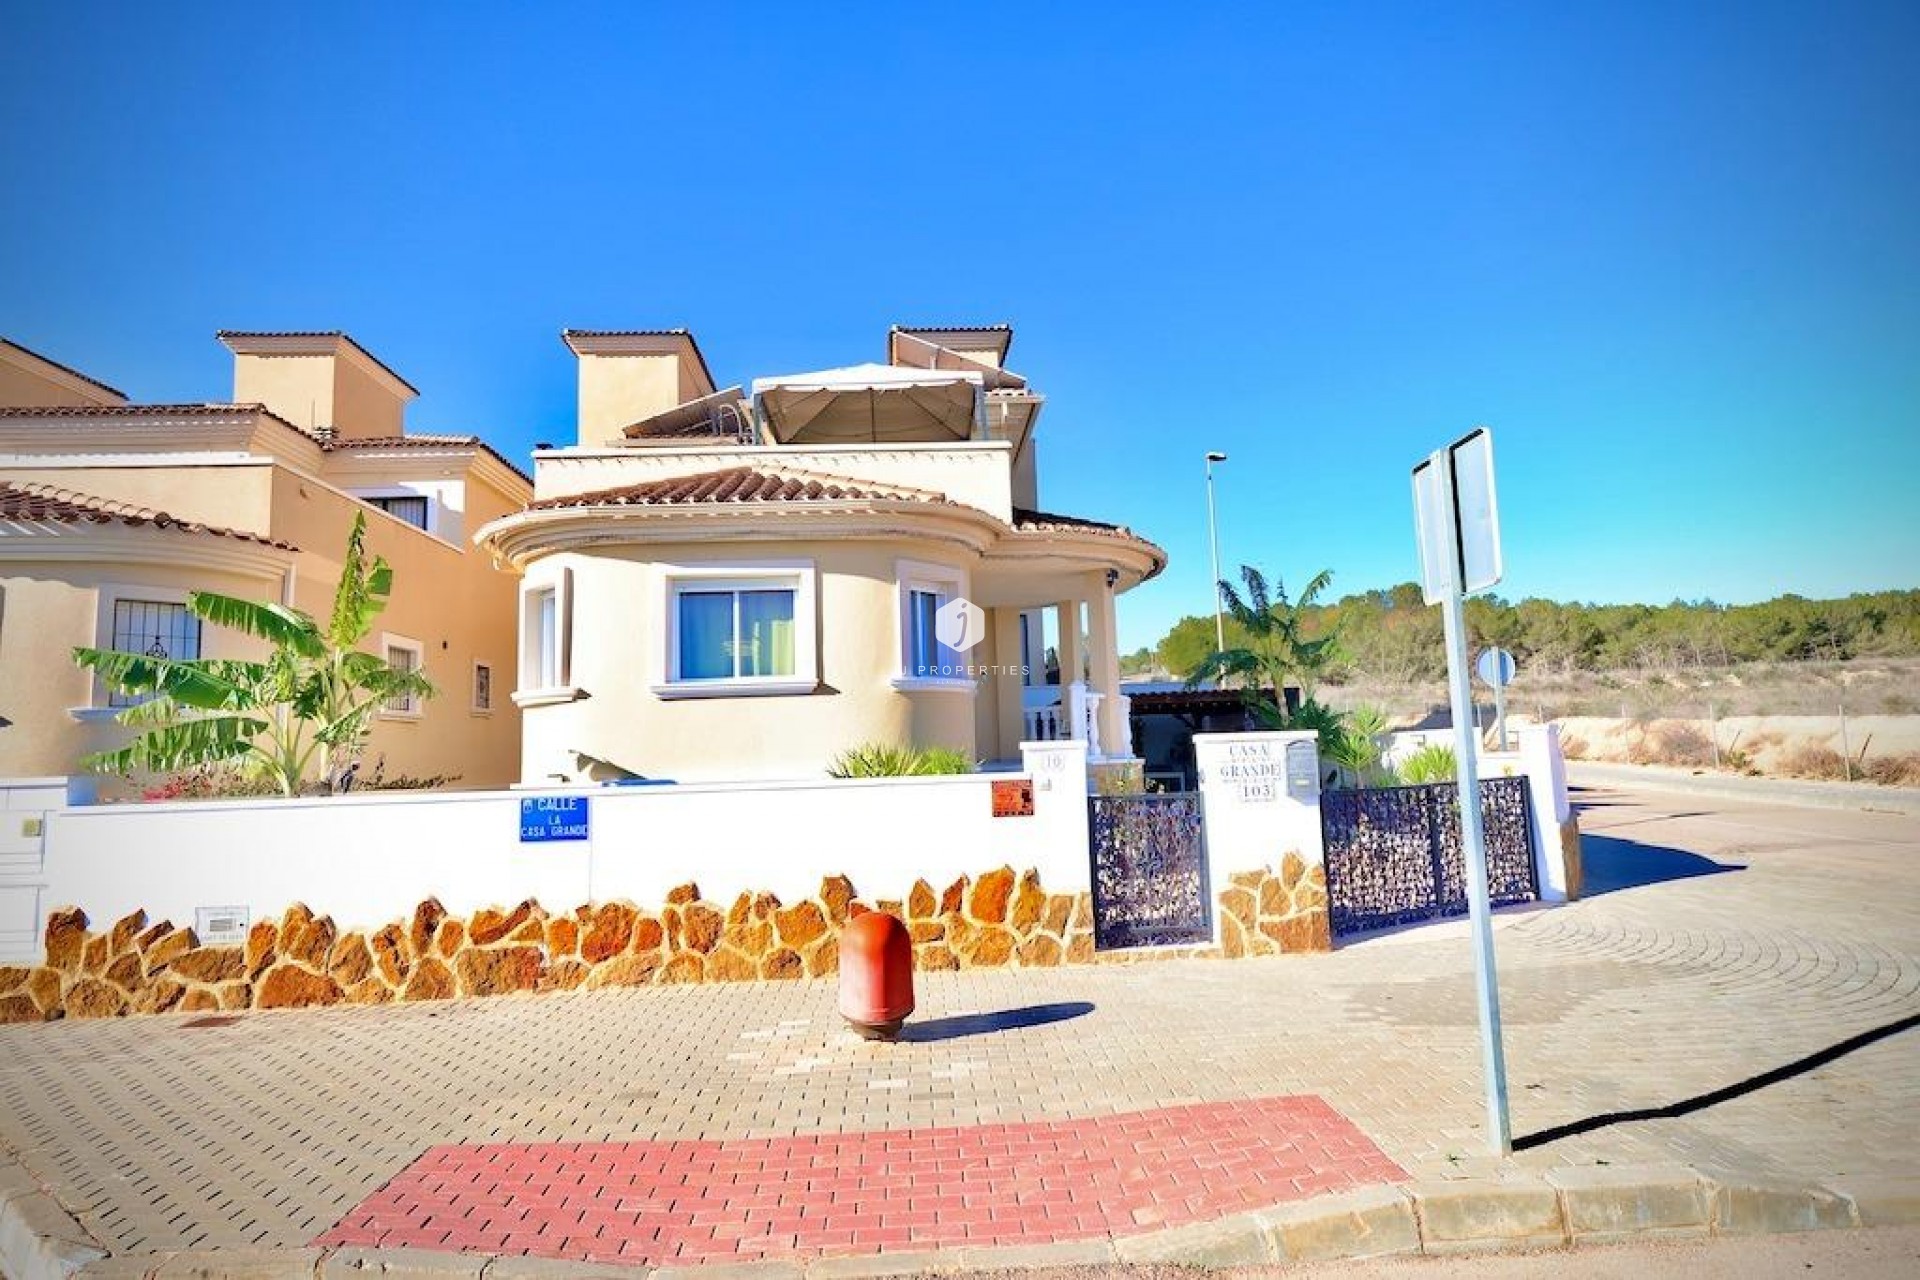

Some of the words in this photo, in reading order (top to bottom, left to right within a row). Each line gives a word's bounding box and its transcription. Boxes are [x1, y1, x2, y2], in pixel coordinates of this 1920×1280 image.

[1229, 745, 1269, 756] CASA
[1220, 764, 1279, 777] GRANDE
[1244, 785, 1270, 797] 103
[538, 797, 577, 811] CALLE
[548, 814, 561, 825] LA
